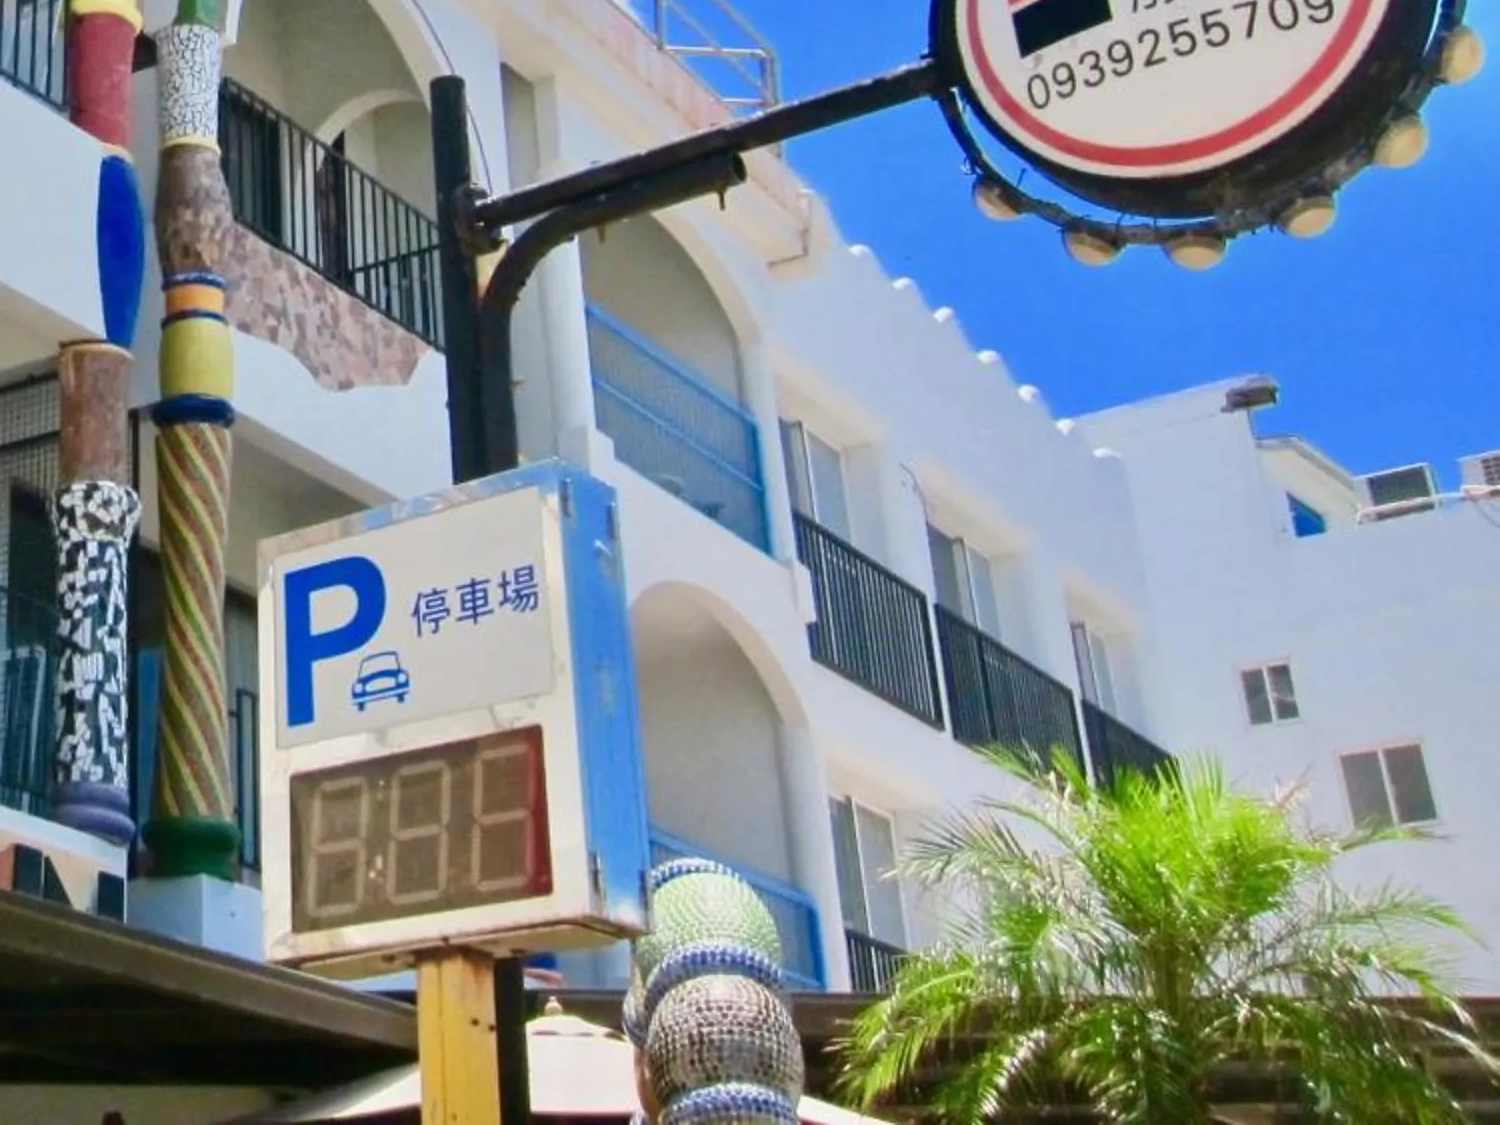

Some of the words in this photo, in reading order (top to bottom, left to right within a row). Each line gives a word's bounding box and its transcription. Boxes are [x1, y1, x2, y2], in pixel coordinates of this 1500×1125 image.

[283, 555, 387, 728] P
[411, 564, 540, 638] 停車場
